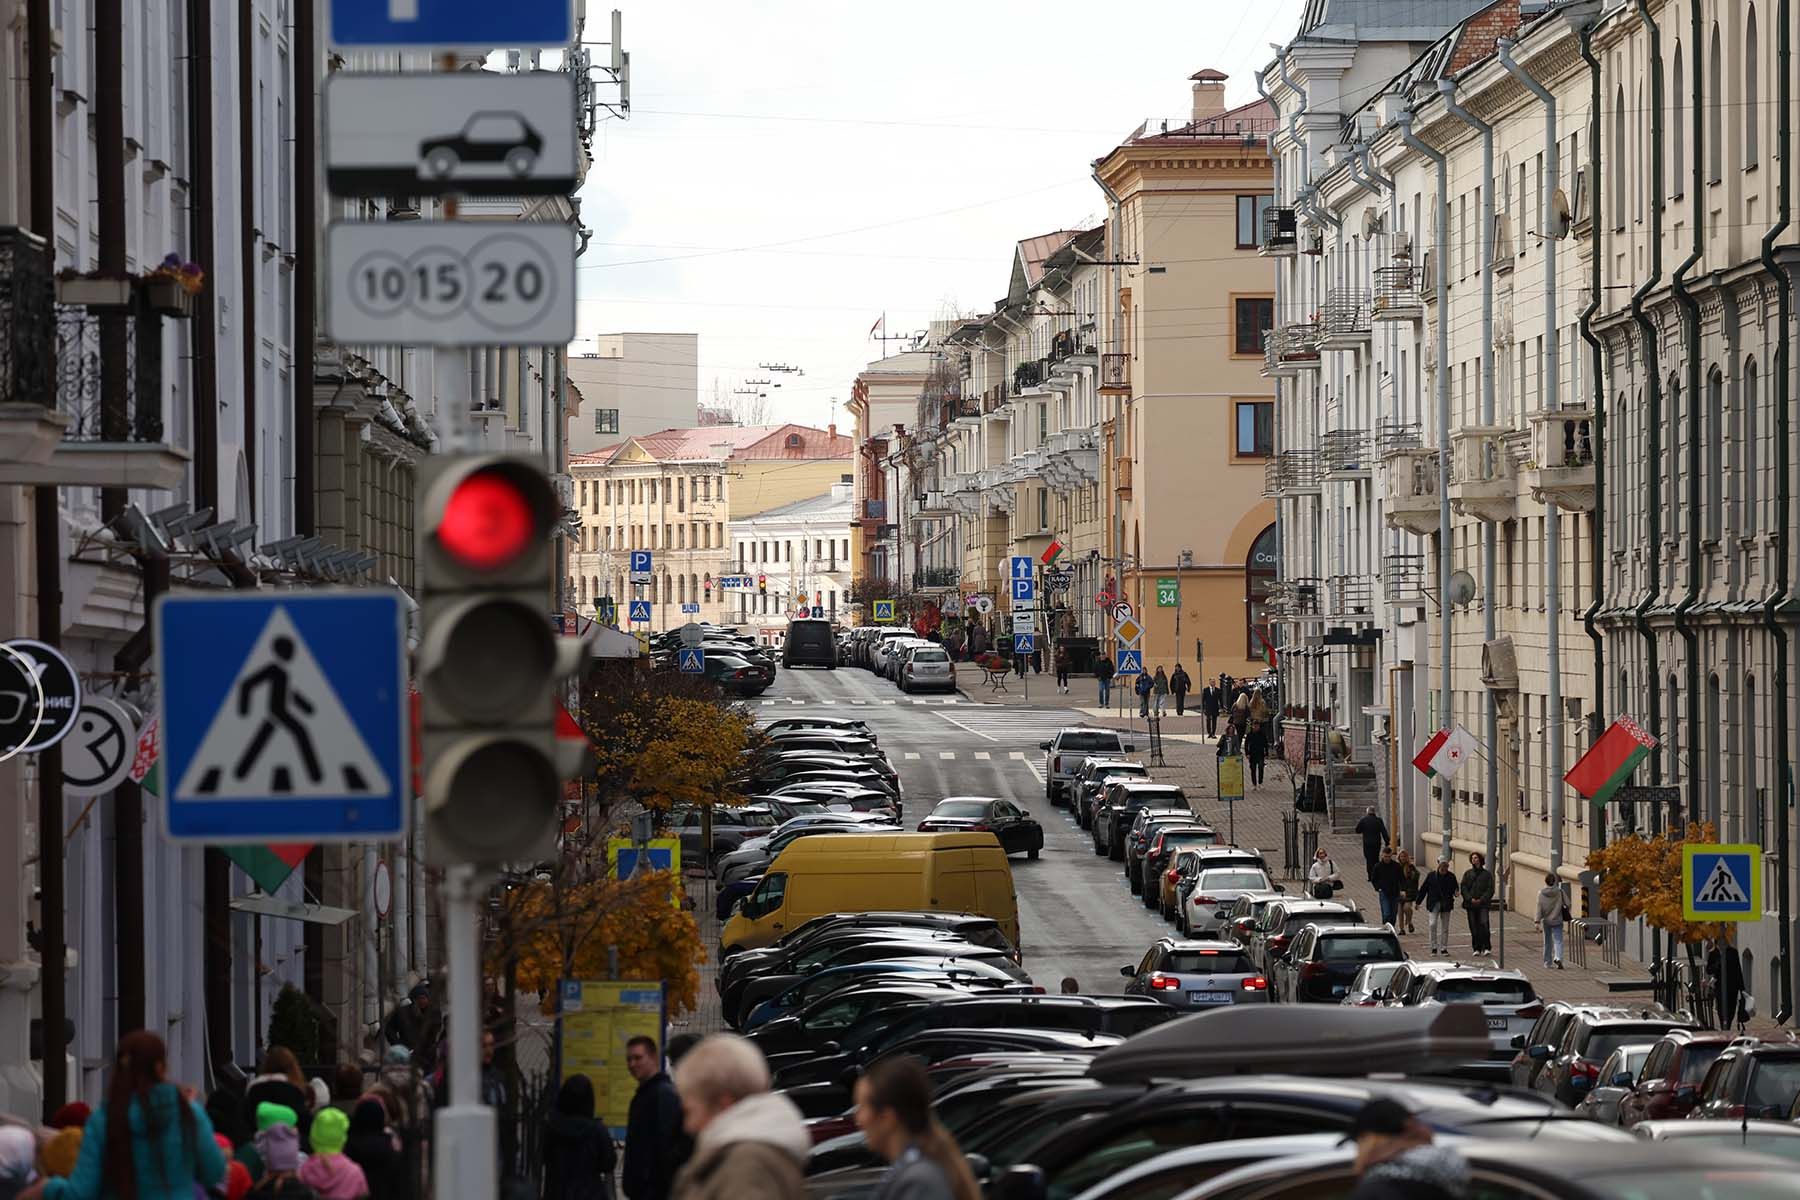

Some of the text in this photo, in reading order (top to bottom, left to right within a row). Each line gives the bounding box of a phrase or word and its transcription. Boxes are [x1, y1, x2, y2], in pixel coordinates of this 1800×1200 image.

[363, 261, 543, 303] 10 15 20
[635, 553, 647, 570] P
[1017, 581, 1029, 598] P
[1160, 590, 1175, 604] 34
